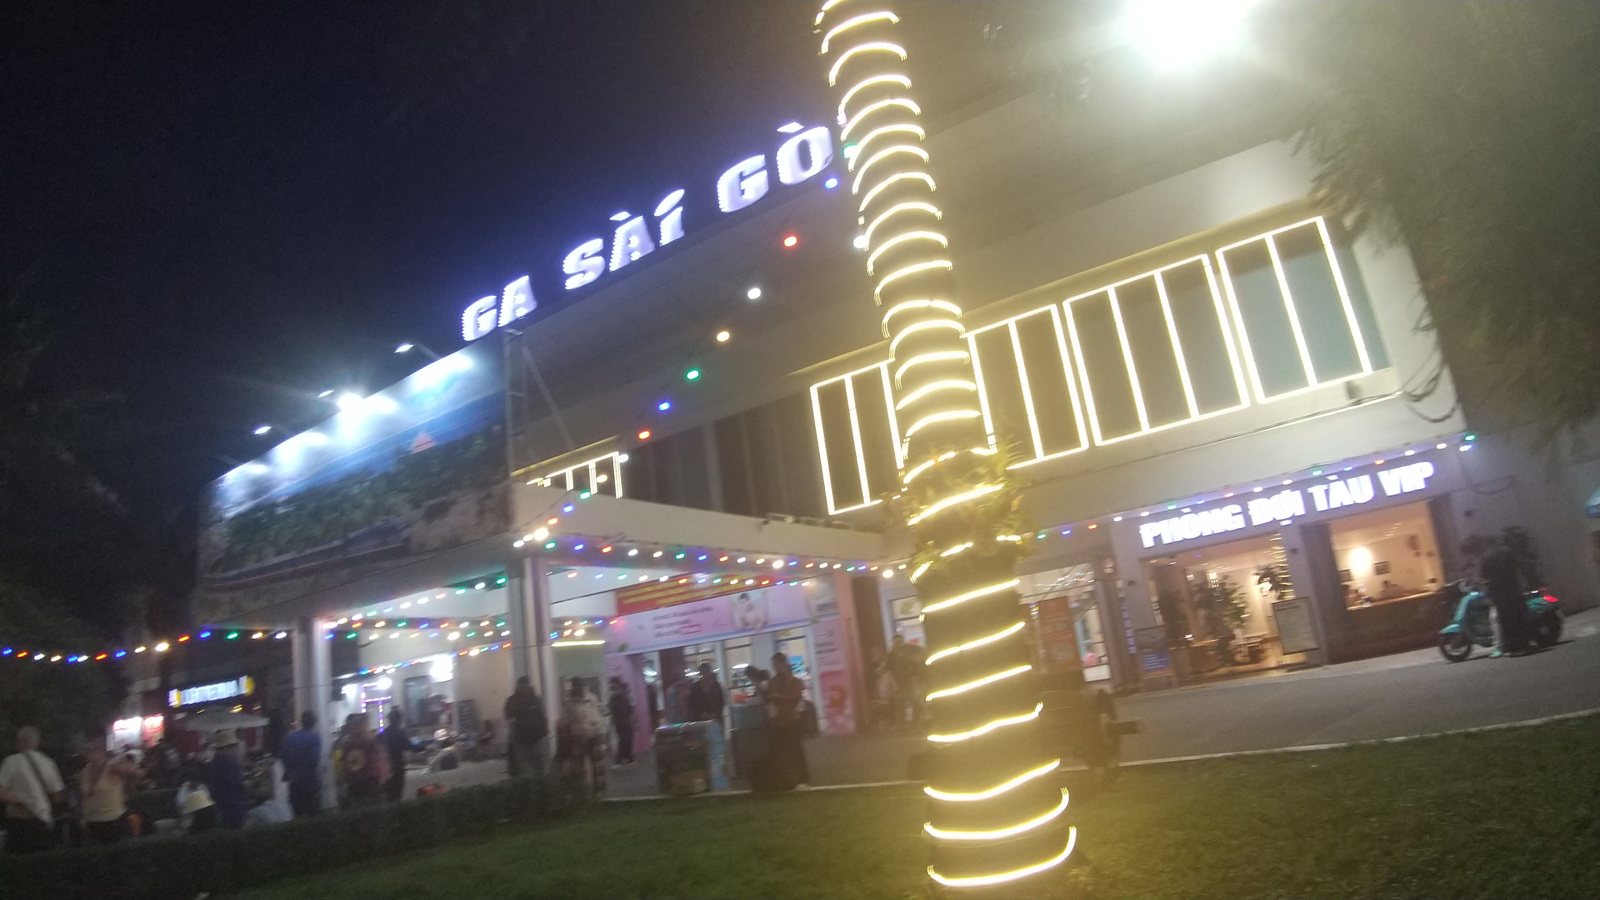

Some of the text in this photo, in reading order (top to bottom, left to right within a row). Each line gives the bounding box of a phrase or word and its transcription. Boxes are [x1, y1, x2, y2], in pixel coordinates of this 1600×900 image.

[461, 274, 538, 342] GA
[716, 121, 834, 213] GÒ
[1139, 504, 1246, 549] PHÒNG
[1307, 474, 1375, 512] TÀU
[1377, 461, 1435, 497] VIP
